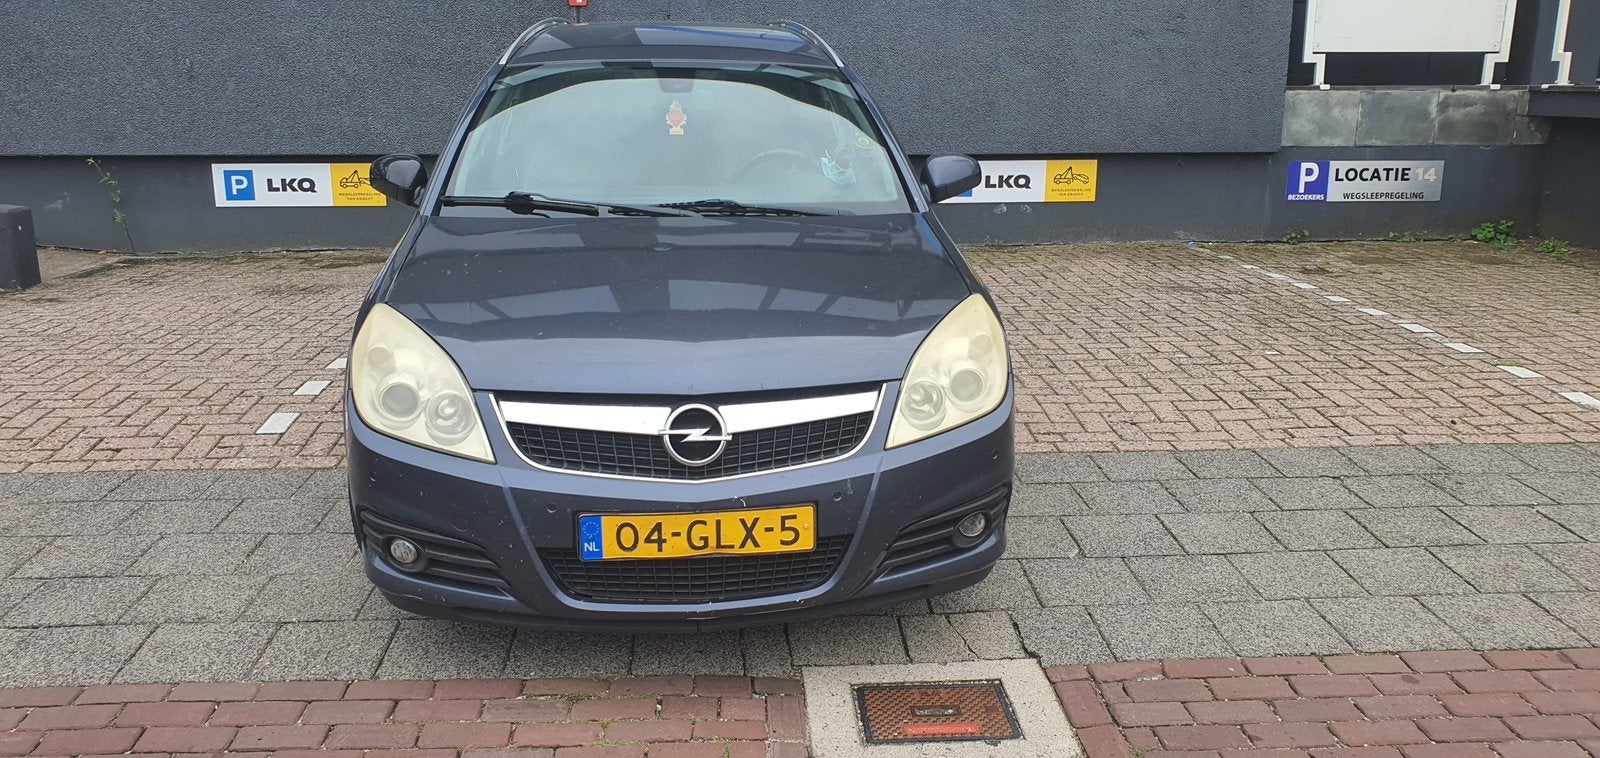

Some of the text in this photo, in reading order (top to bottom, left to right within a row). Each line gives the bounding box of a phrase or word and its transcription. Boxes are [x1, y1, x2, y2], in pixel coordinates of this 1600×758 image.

[985, 174, 1031, 189] LKQ
[1298, 162, 1320, 193] P
[1334, 167, 1437, 182] LOCATIE 14
[231, 175, 248, 195] P
[266, 177, 317, 193] LKQ
[1343, 192, 1424, 200] WEGSLEEPREGELING
[615, 514, 801, 552] 04-GLX-5
[584, 542, 600, 552] NL
